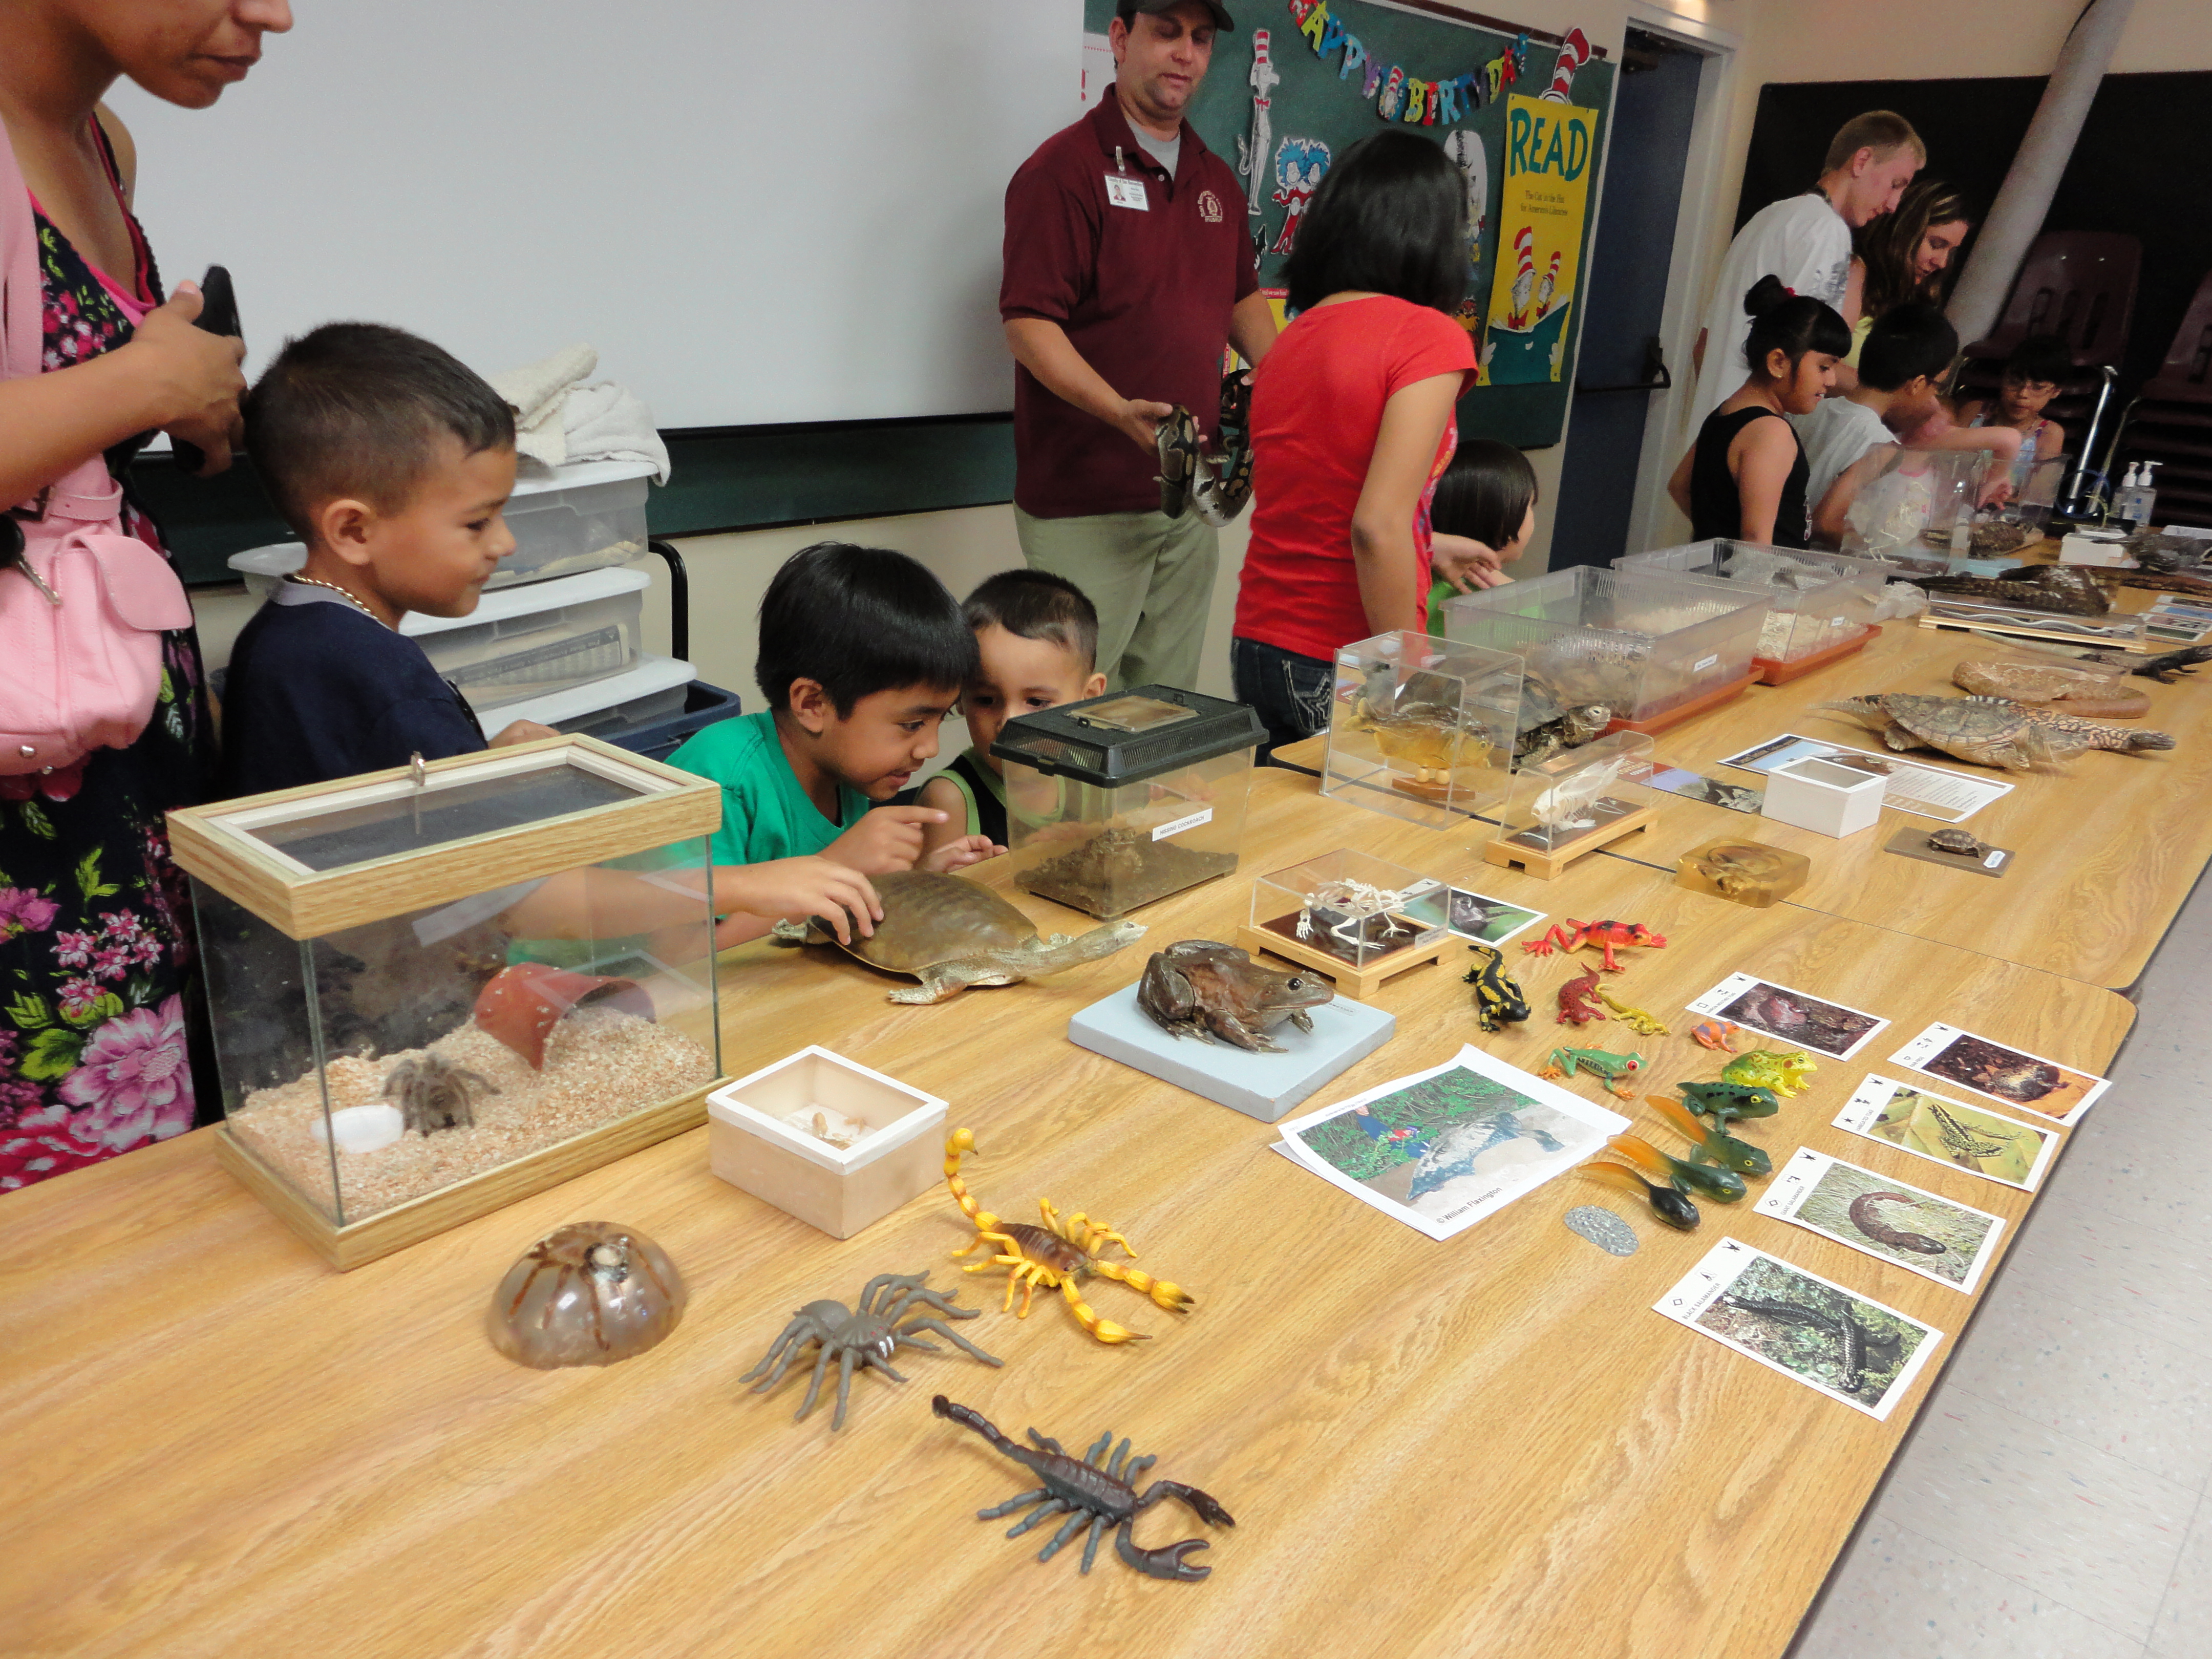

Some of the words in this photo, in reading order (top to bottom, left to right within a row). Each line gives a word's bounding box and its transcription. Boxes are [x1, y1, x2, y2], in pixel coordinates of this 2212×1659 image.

[1404, 33, 1528, 126] BIRTDAY
[1510, 108, 1588, 182] READ
[1160, 825, 1177, 836] HISSING
[1178, 815, 1205, 829] COCKROACH
[1442, 1205, 1470, 1221] William
[1466, 1187, 1503, 1207] Flaxington
[1787, 1185, 1805, 1206] SALAMANDER
[1682, 1306, 1697, 1320] BLACK
[1694, 1282, 1721, 1308] SALAMANDER
